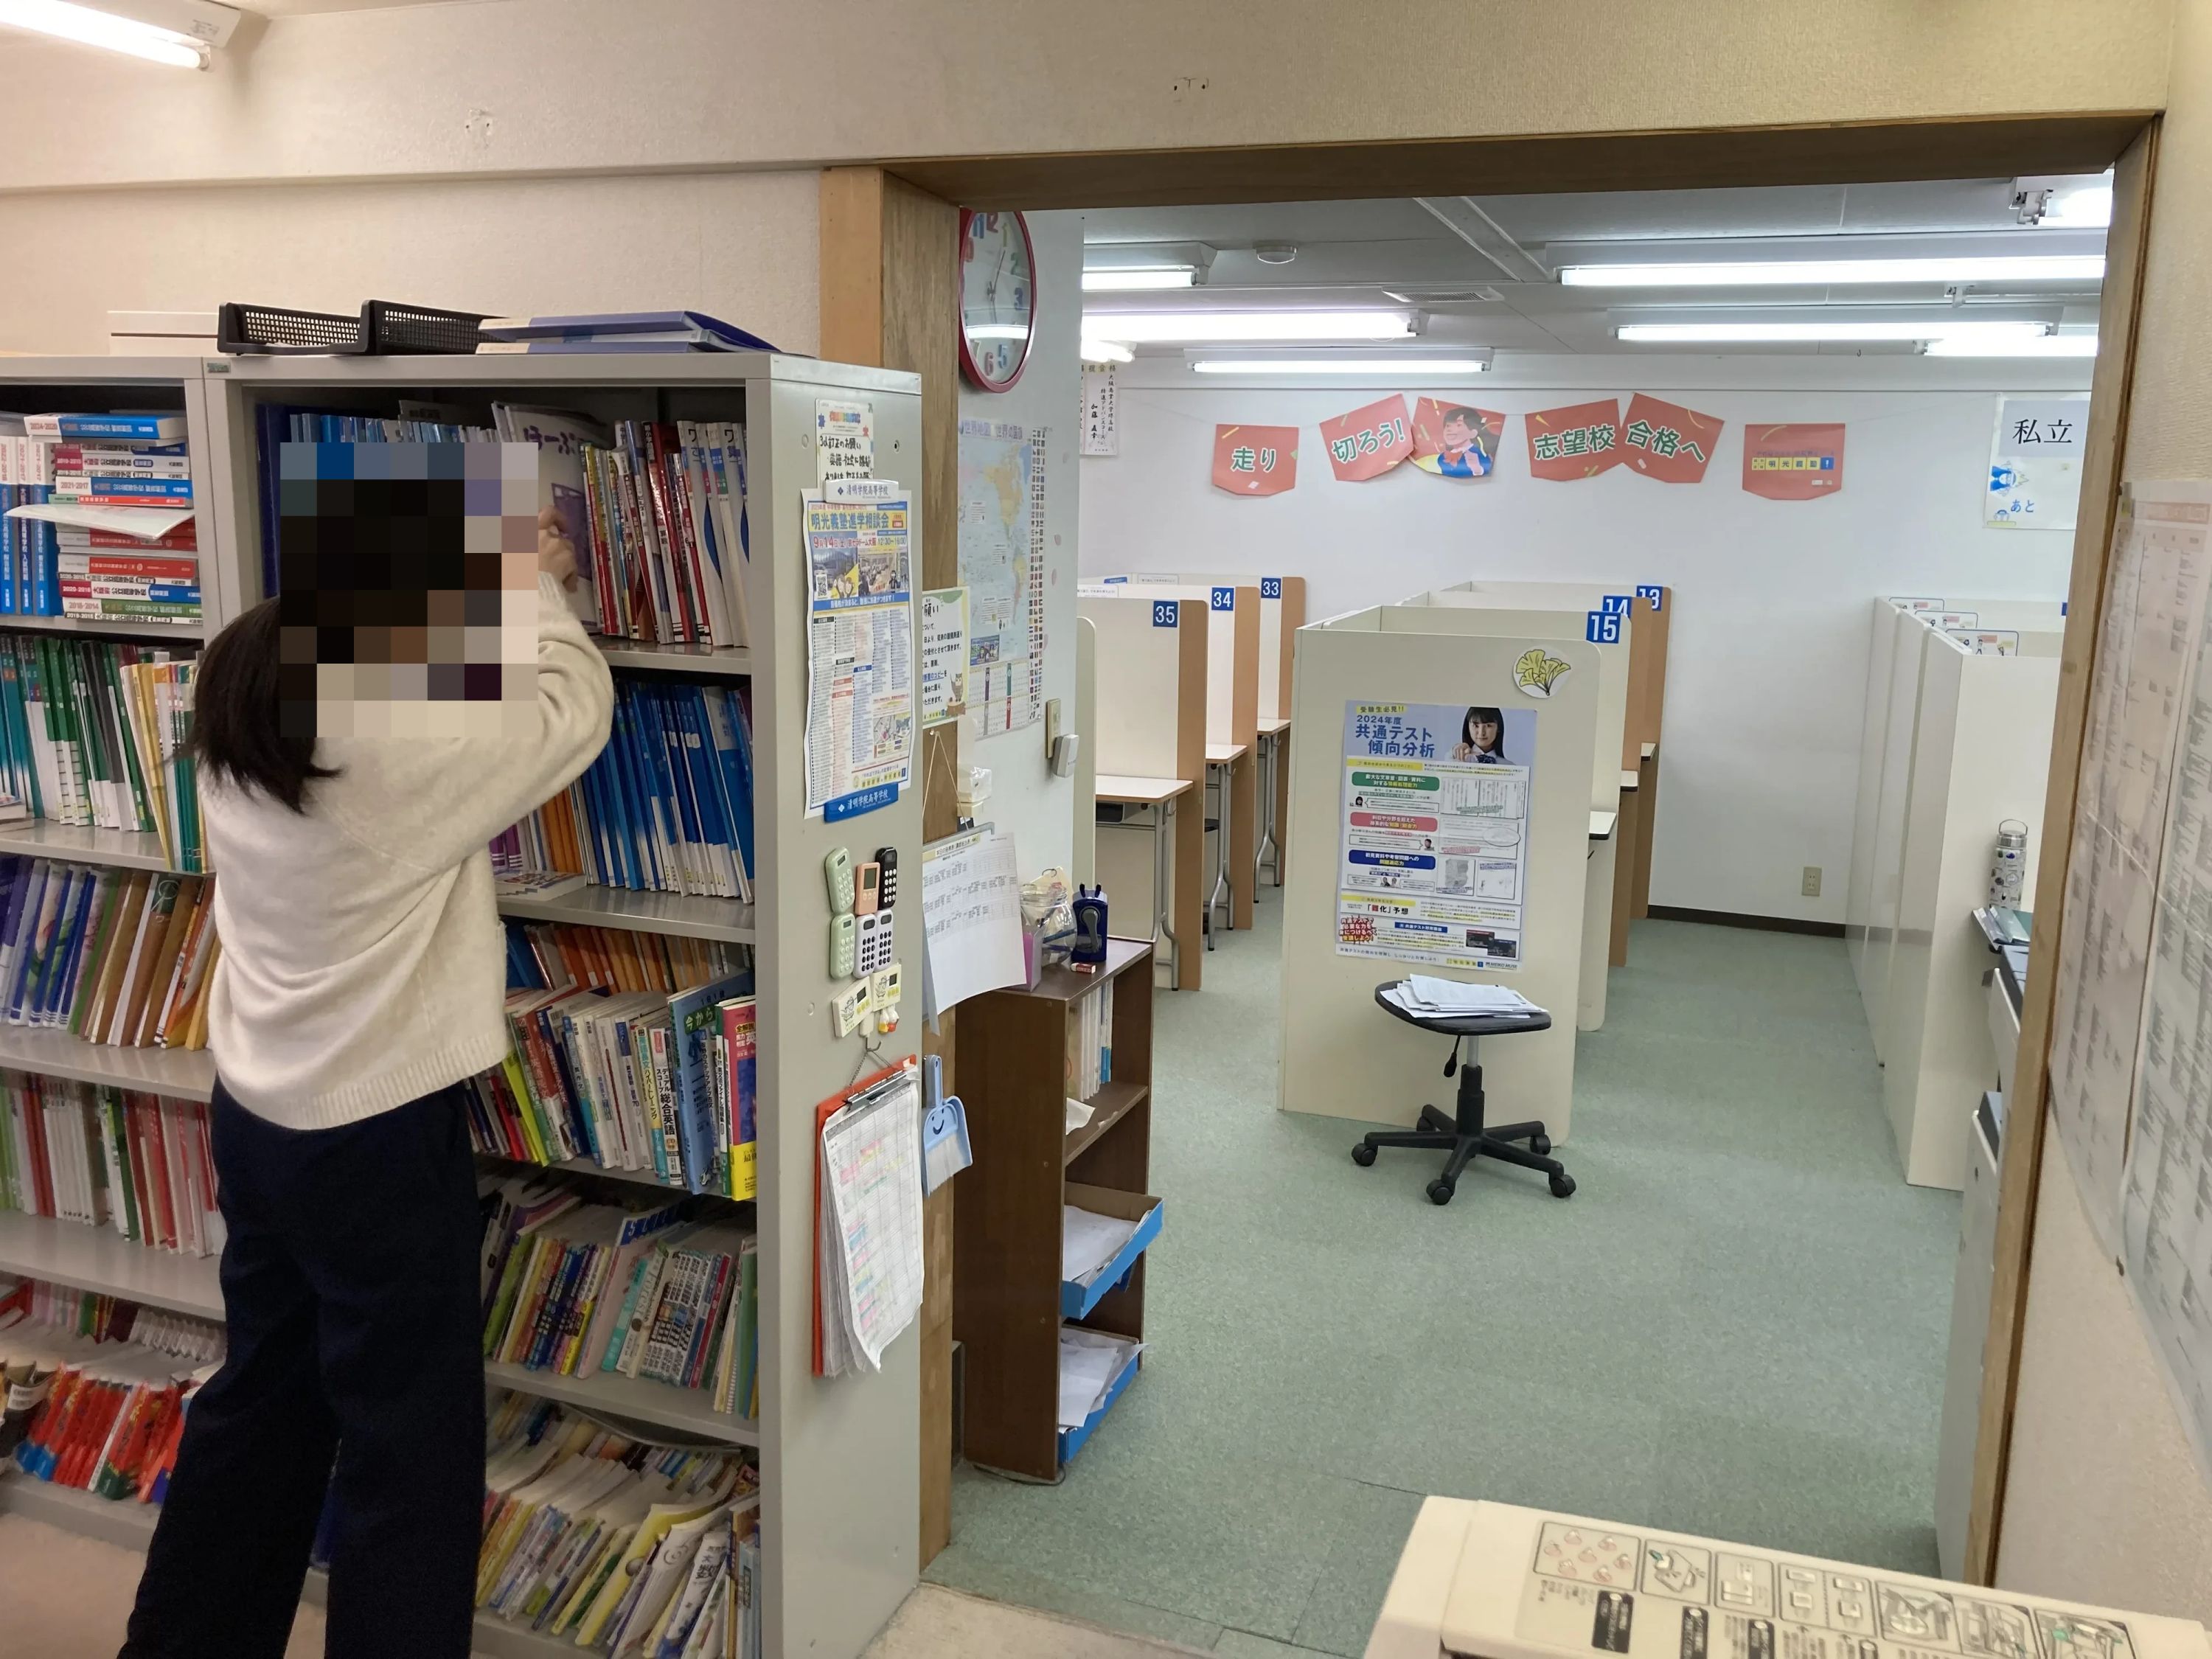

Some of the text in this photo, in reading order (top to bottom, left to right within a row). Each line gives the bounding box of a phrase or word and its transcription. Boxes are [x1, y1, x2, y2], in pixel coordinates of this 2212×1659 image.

[1534, 424, 1616, 460] 志望校
[1625, 419, 1705, 463] 合格へ
[2012, 419, 2073, 445] 私立
[1231, 446, 1276, 472] 走り
[2011, 499, 2035, 513] あと
[1262, 581, 1279, 596] 33
[1213, 591, 1231, 607] 34
[1155, 605, 1175, 623] 35
[1591, 615, 1618, 641] 15
[1357, 715, 1402, 725] 2024年度
[1355, 724, 1433, 742] 共通テスト
[1368, 739, 1435, 758] 傾向分析
[685, 1009, 714, 1031] 今から
[661, 1093, 675, 1135] 総合英語
